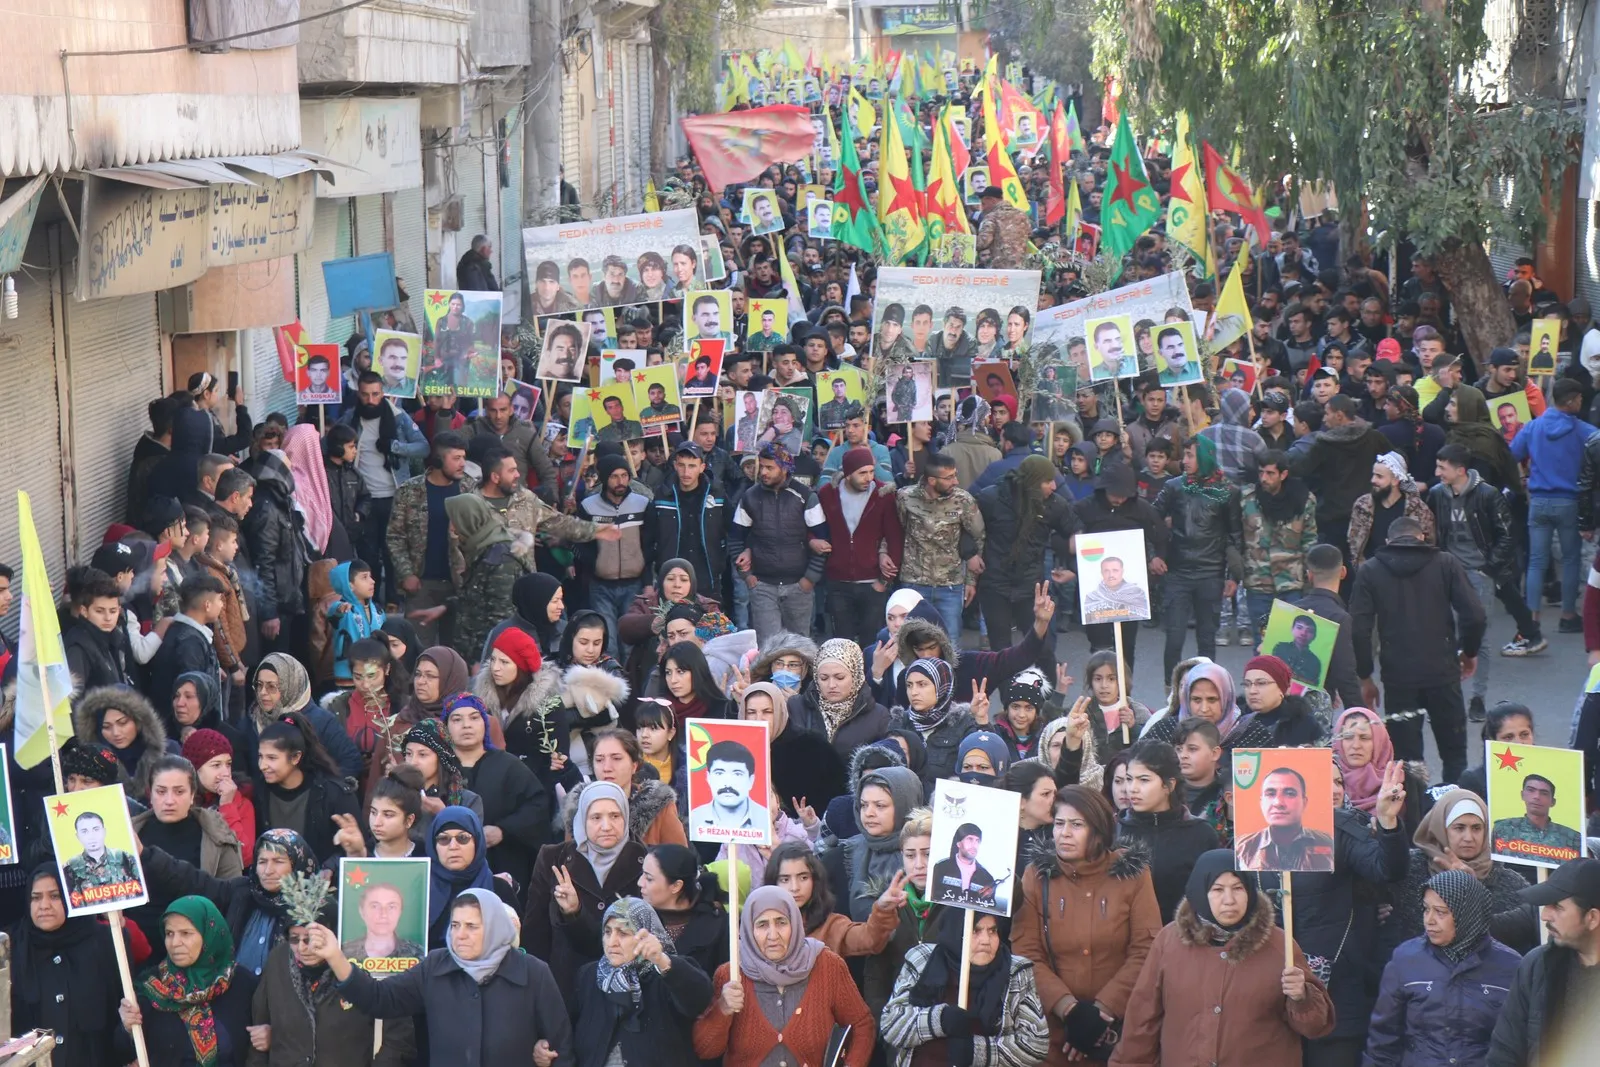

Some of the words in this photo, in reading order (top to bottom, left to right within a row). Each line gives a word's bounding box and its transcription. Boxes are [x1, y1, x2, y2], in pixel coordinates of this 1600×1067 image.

[457, 386, 492, 397] SILAVA
[84, 881, 141, 902] MUSTAFA
[942, 889, 956, 902] بكر
[976, 897, 994, 907] شهيد
